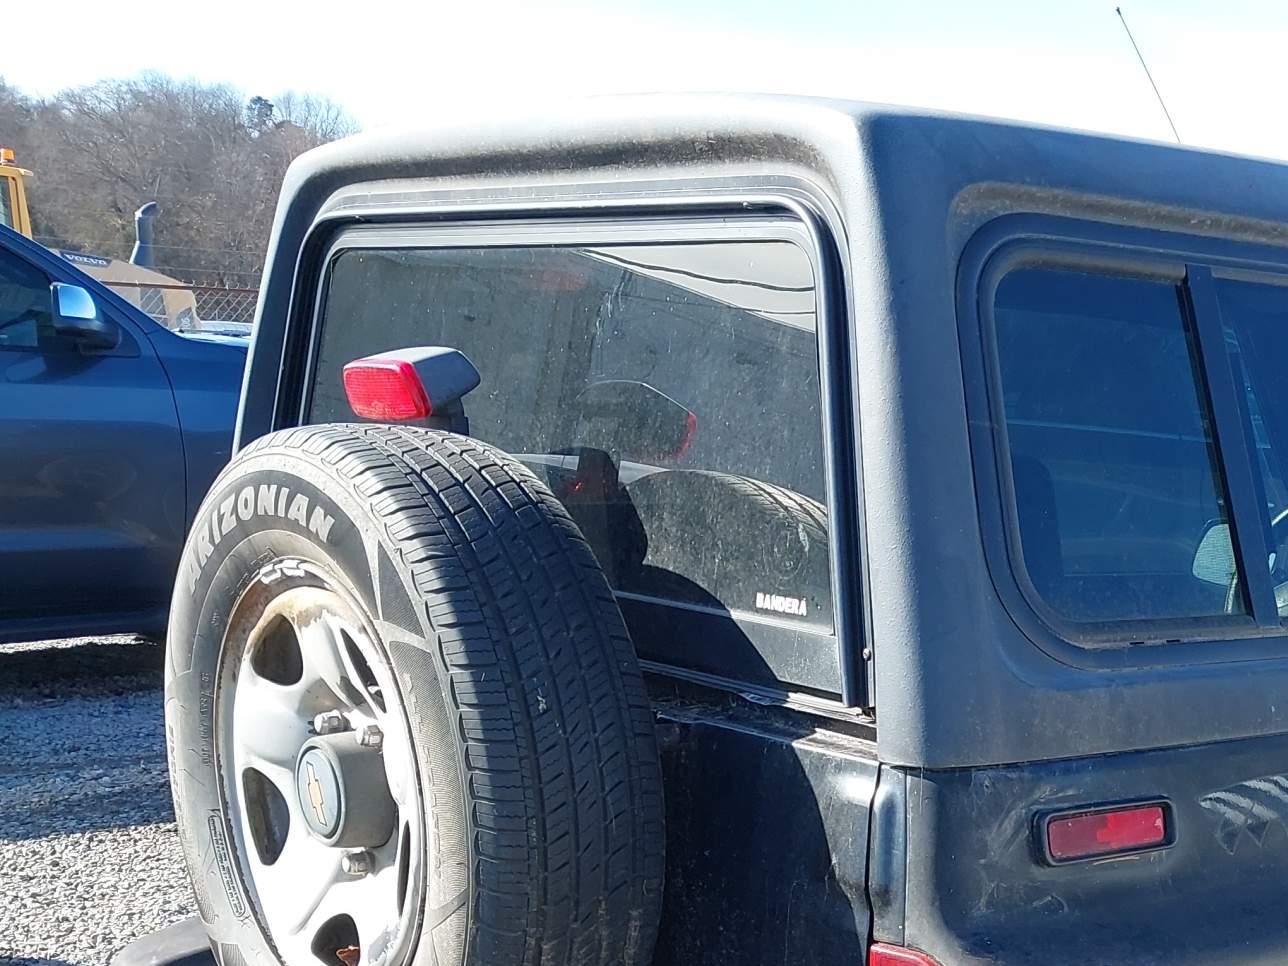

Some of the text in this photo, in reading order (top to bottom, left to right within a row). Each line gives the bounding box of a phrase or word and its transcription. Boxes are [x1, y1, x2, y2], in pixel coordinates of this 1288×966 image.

[63, 253, 107, 265] VOLVO
[187, 484, 336, 597] ARIZONIAN
[755, 592, 808, 617] BANDERA
